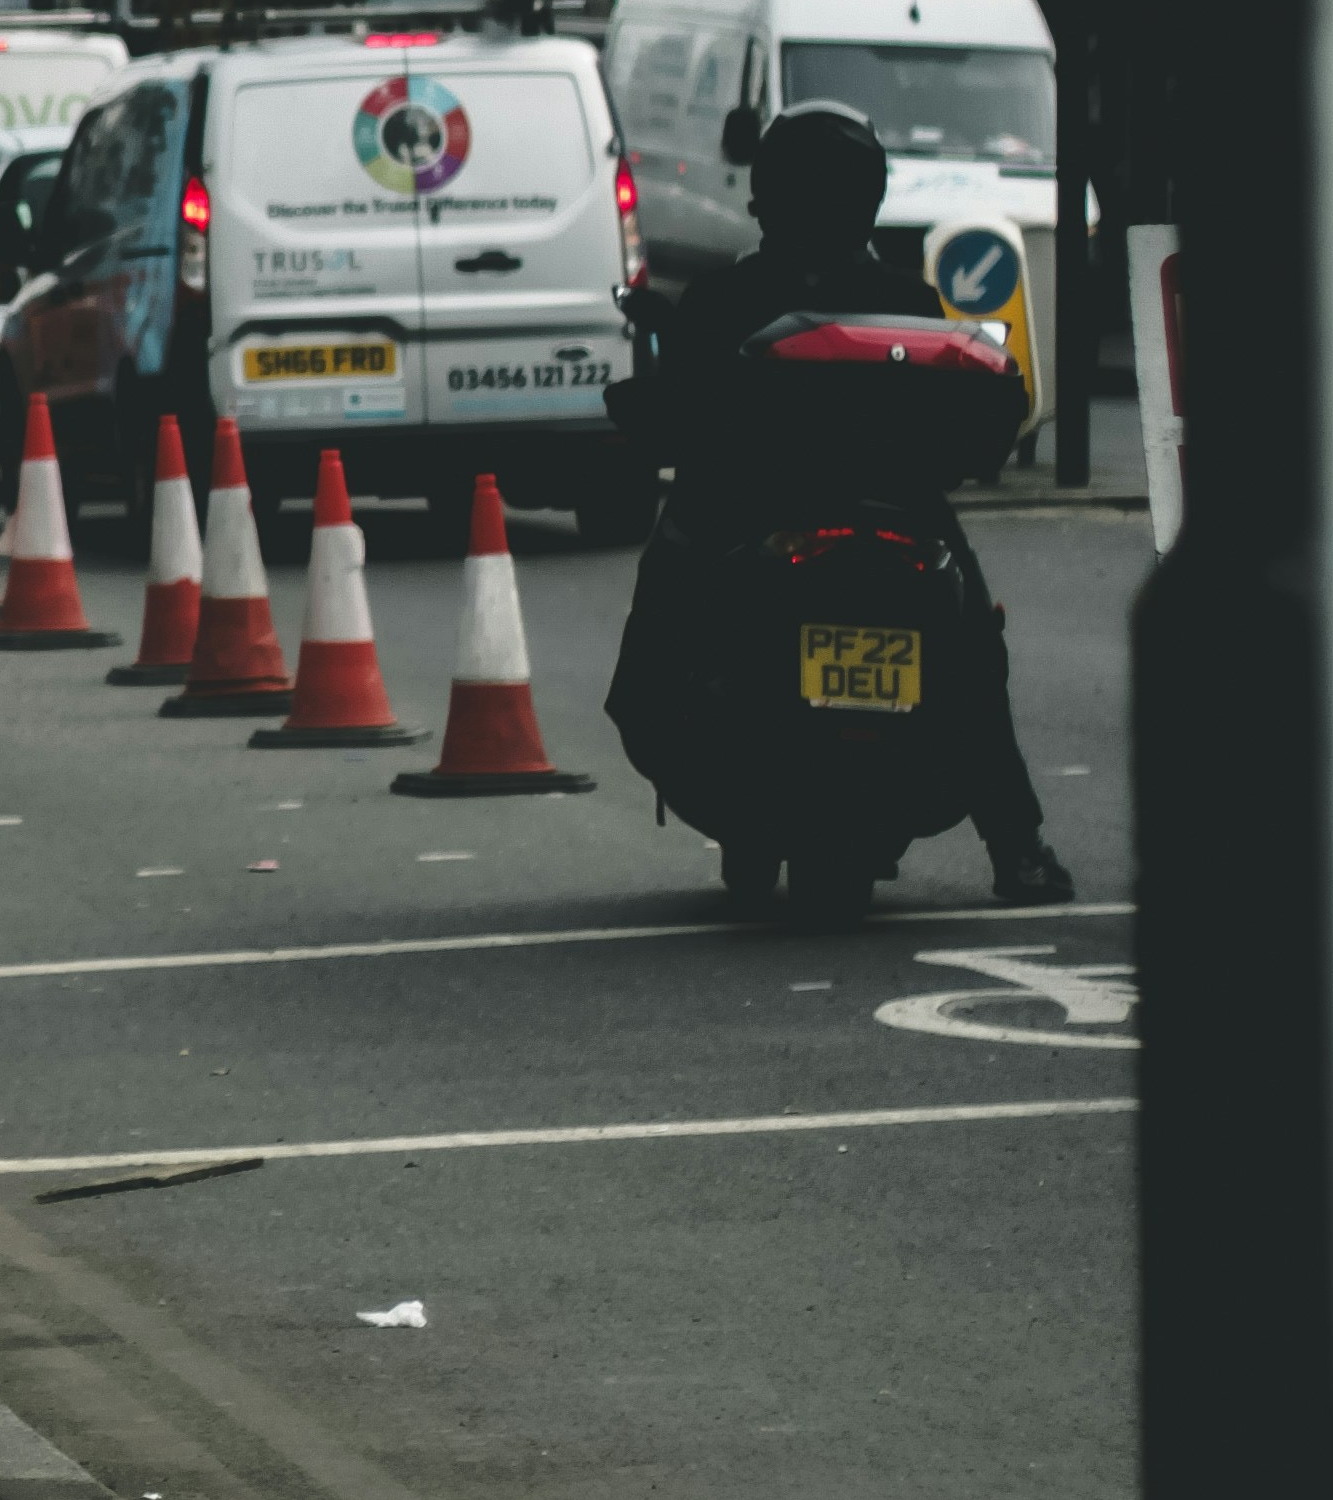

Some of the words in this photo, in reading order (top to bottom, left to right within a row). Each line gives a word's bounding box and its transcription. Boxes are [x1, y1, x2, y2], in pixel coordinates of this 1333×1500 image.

[447, 367, 528, 392] 03456
[532, 364, 564, 388] 121
[570, 362, 612, 387] 222
[806, 627, 915, 667] PF22
[821, 663, 900, 699] DEU
